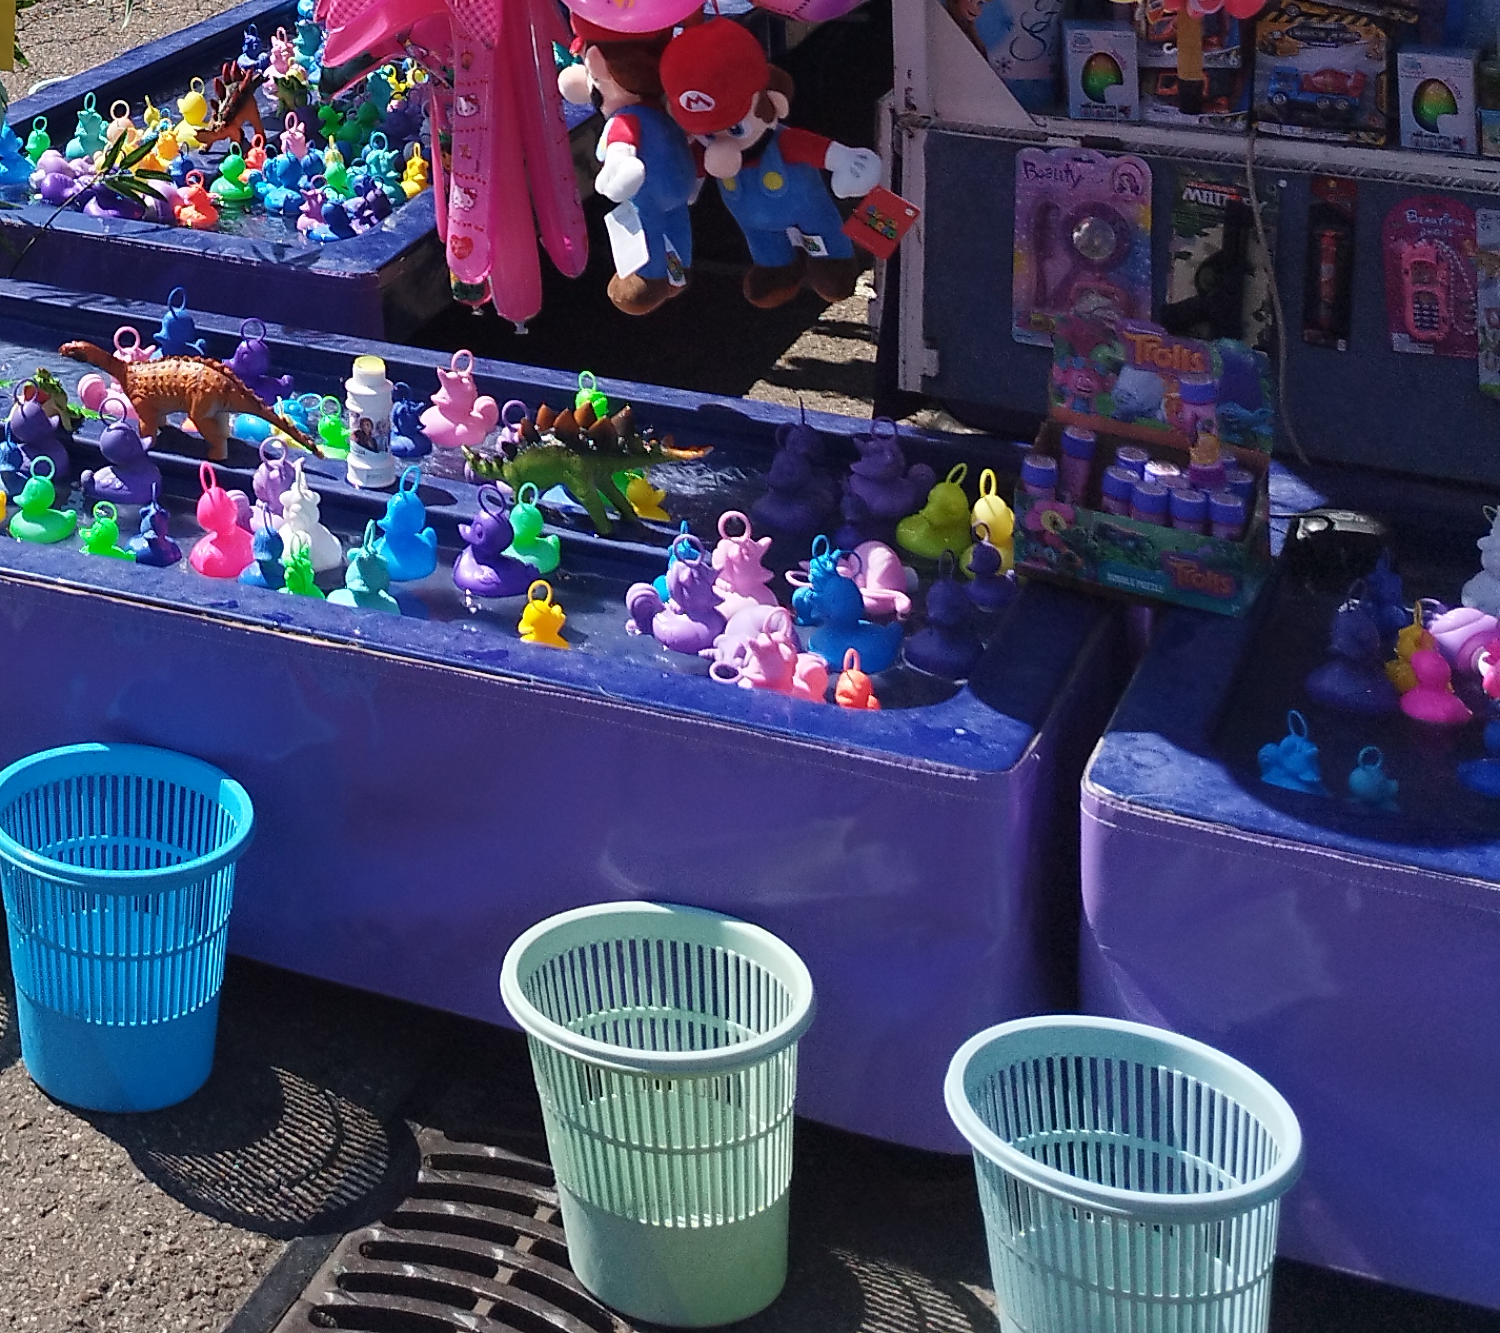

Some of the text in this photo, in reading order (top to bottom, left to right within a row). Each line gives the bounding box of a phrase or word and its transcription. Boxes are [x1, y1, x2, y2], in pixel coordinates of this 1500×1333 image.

[686, 94, 712, 109] M
[1123, 331, 1206, 372] Trolls
[1167, 559, 1231, 593] Trolls
